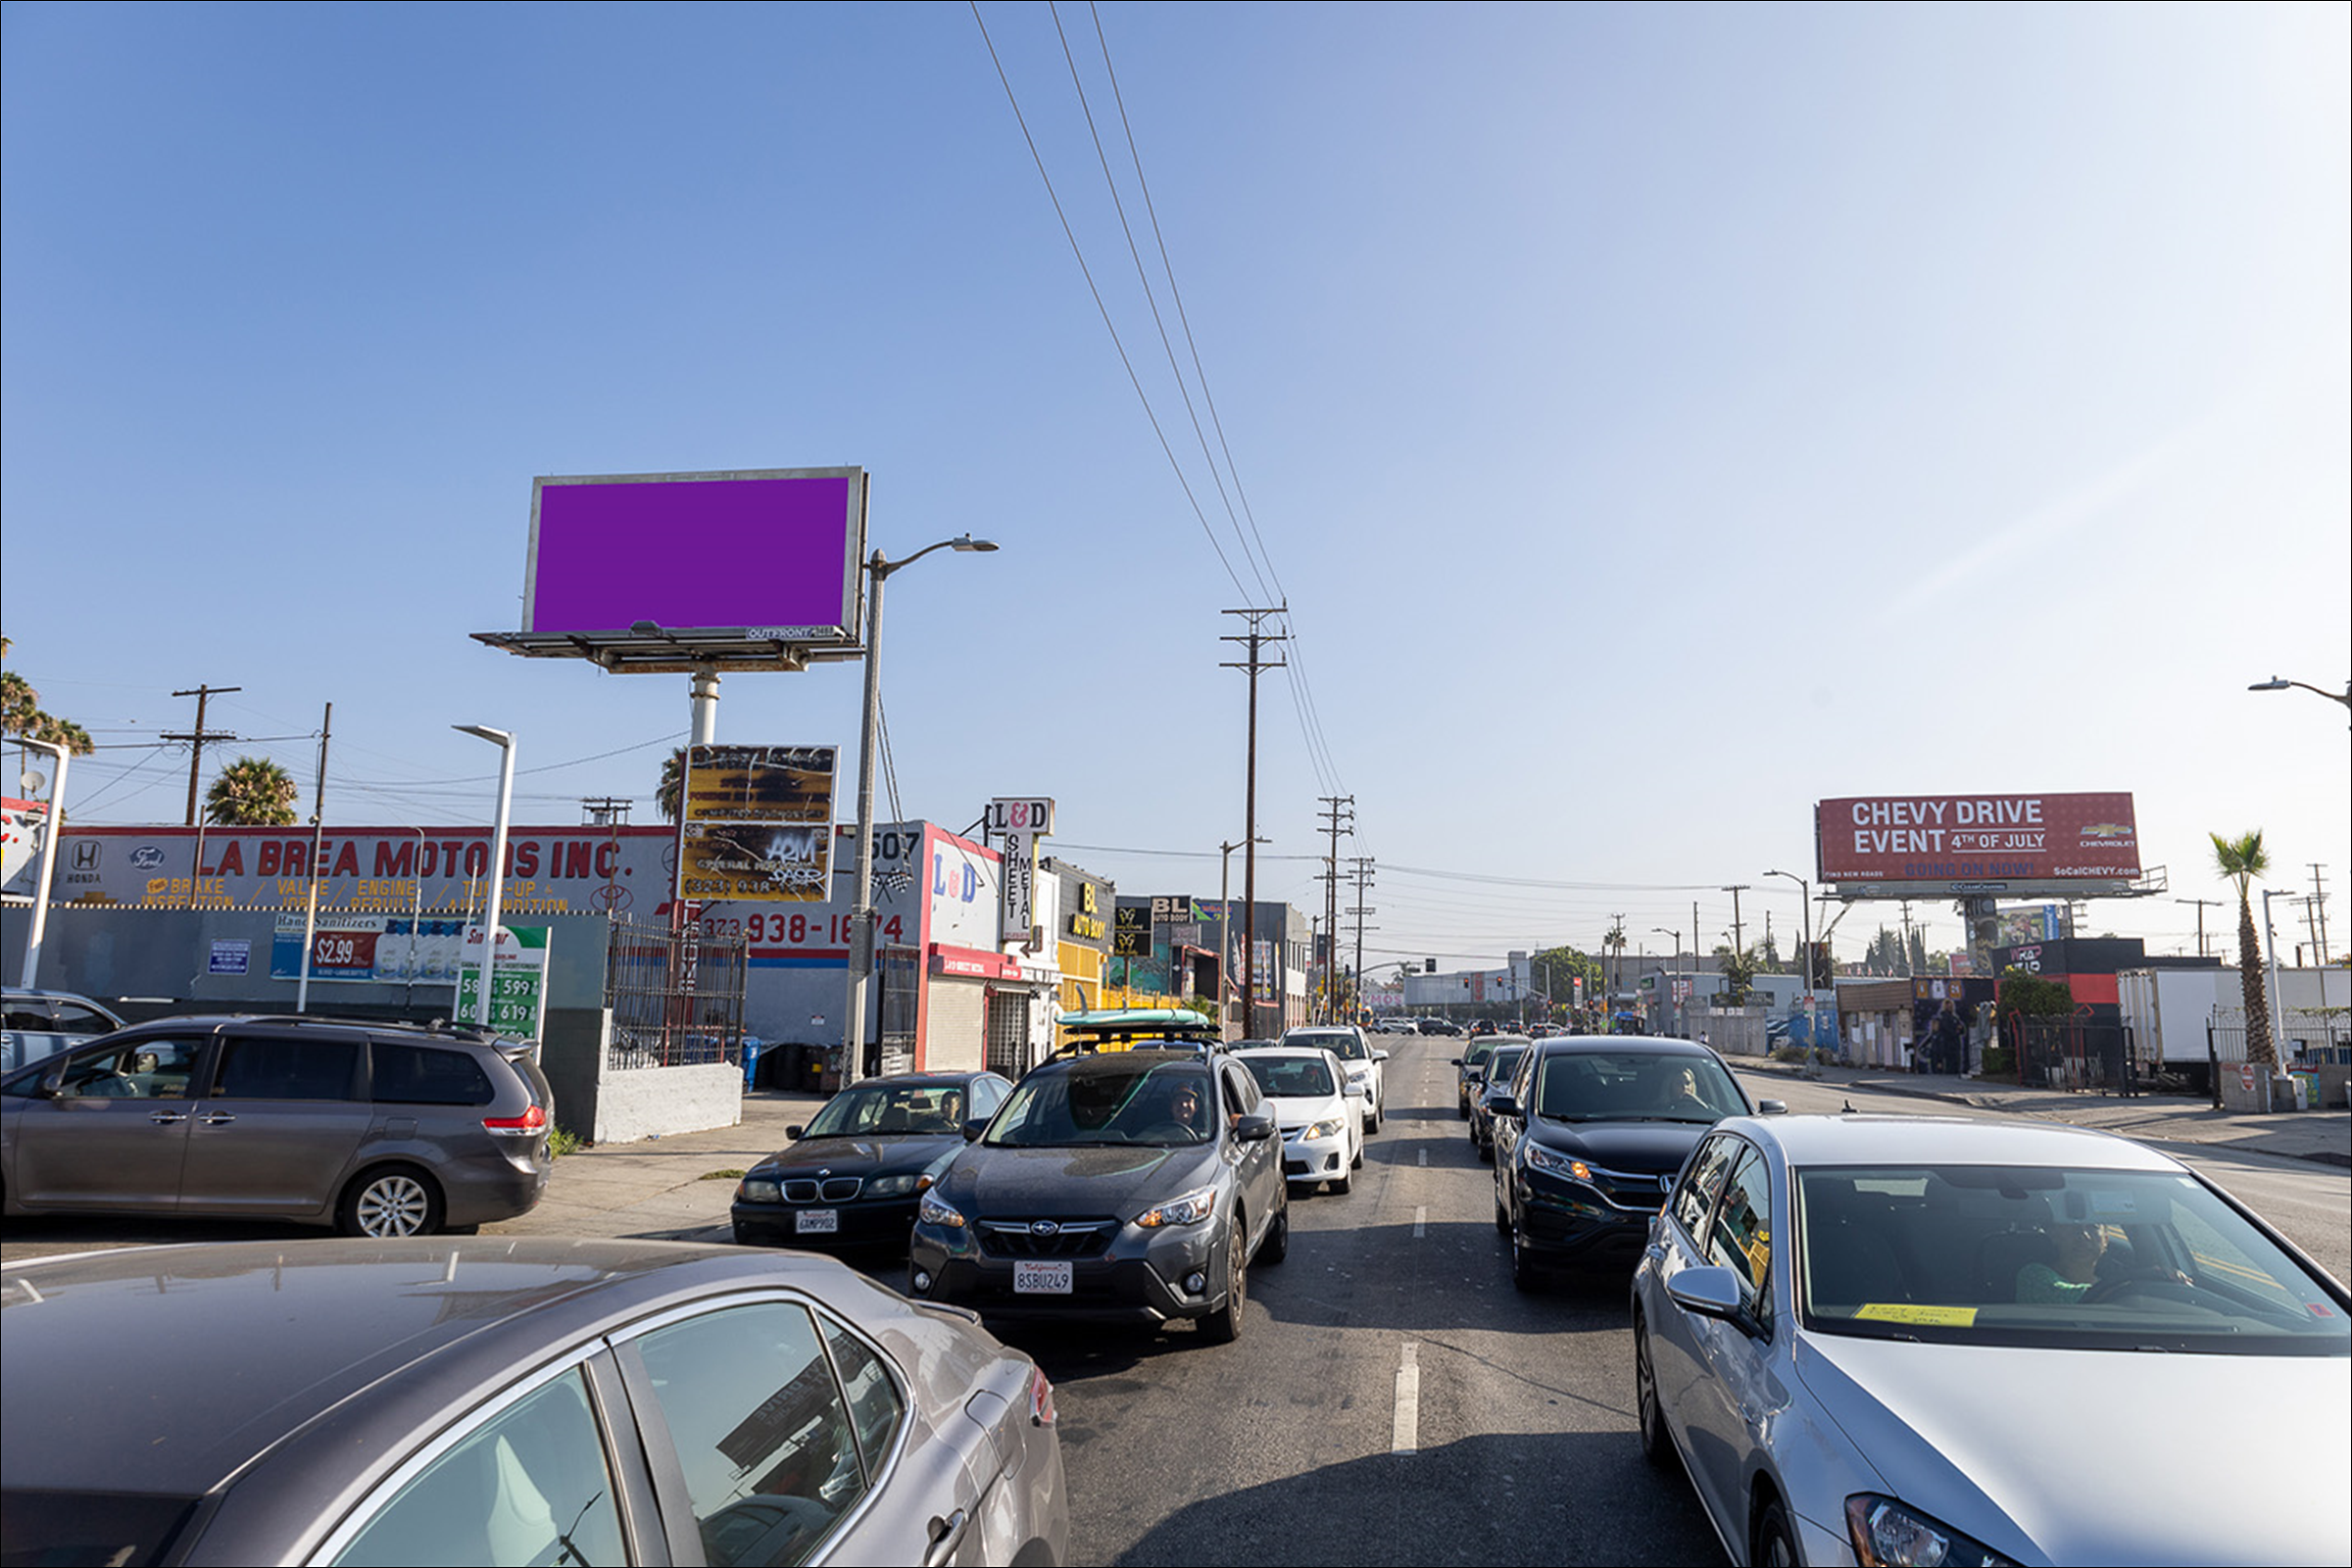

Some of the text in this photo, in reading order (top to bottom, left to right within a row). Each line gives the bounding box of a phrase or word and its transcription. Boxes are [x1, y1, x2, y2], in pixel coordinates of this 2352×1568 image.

[994, 802, 1047, 829] L&D
[1852, 800, 2043, 825] CHEVY DRIVE
[1854, 830, 1945, 853] EVENT
[1951, 834, 2045, 849] 4TH OF JULY
[132, 847, 165, 870] Ford
[196, 840, 633, 878] LA BREA MOTOS INC.
[67, 873, 102, 884] HONDA
[933, 853, 977, 904] L&D
[1006, 833, 1020, 919] SHEET
[1904, 862, 2034, 877] GOING ON NOW!
[171, 878, 225, 895] BRAKE
[357, 880, 416, 896] ENGINE
[462, 880, 536, 897] TU-UP
[1019, 858, 1032, 930] METAL
[479, 899, 568, 910] CNDITION
[1152, 898, 1189, 913] BL
[313, 916, 376, 929] Sanitizers
[316, 937, 355, 964] $2.99
[463, 978, 479, 994] 58
[503, 979, 530, 996] 599
[460, 1003, 527, 1021] 60 619
